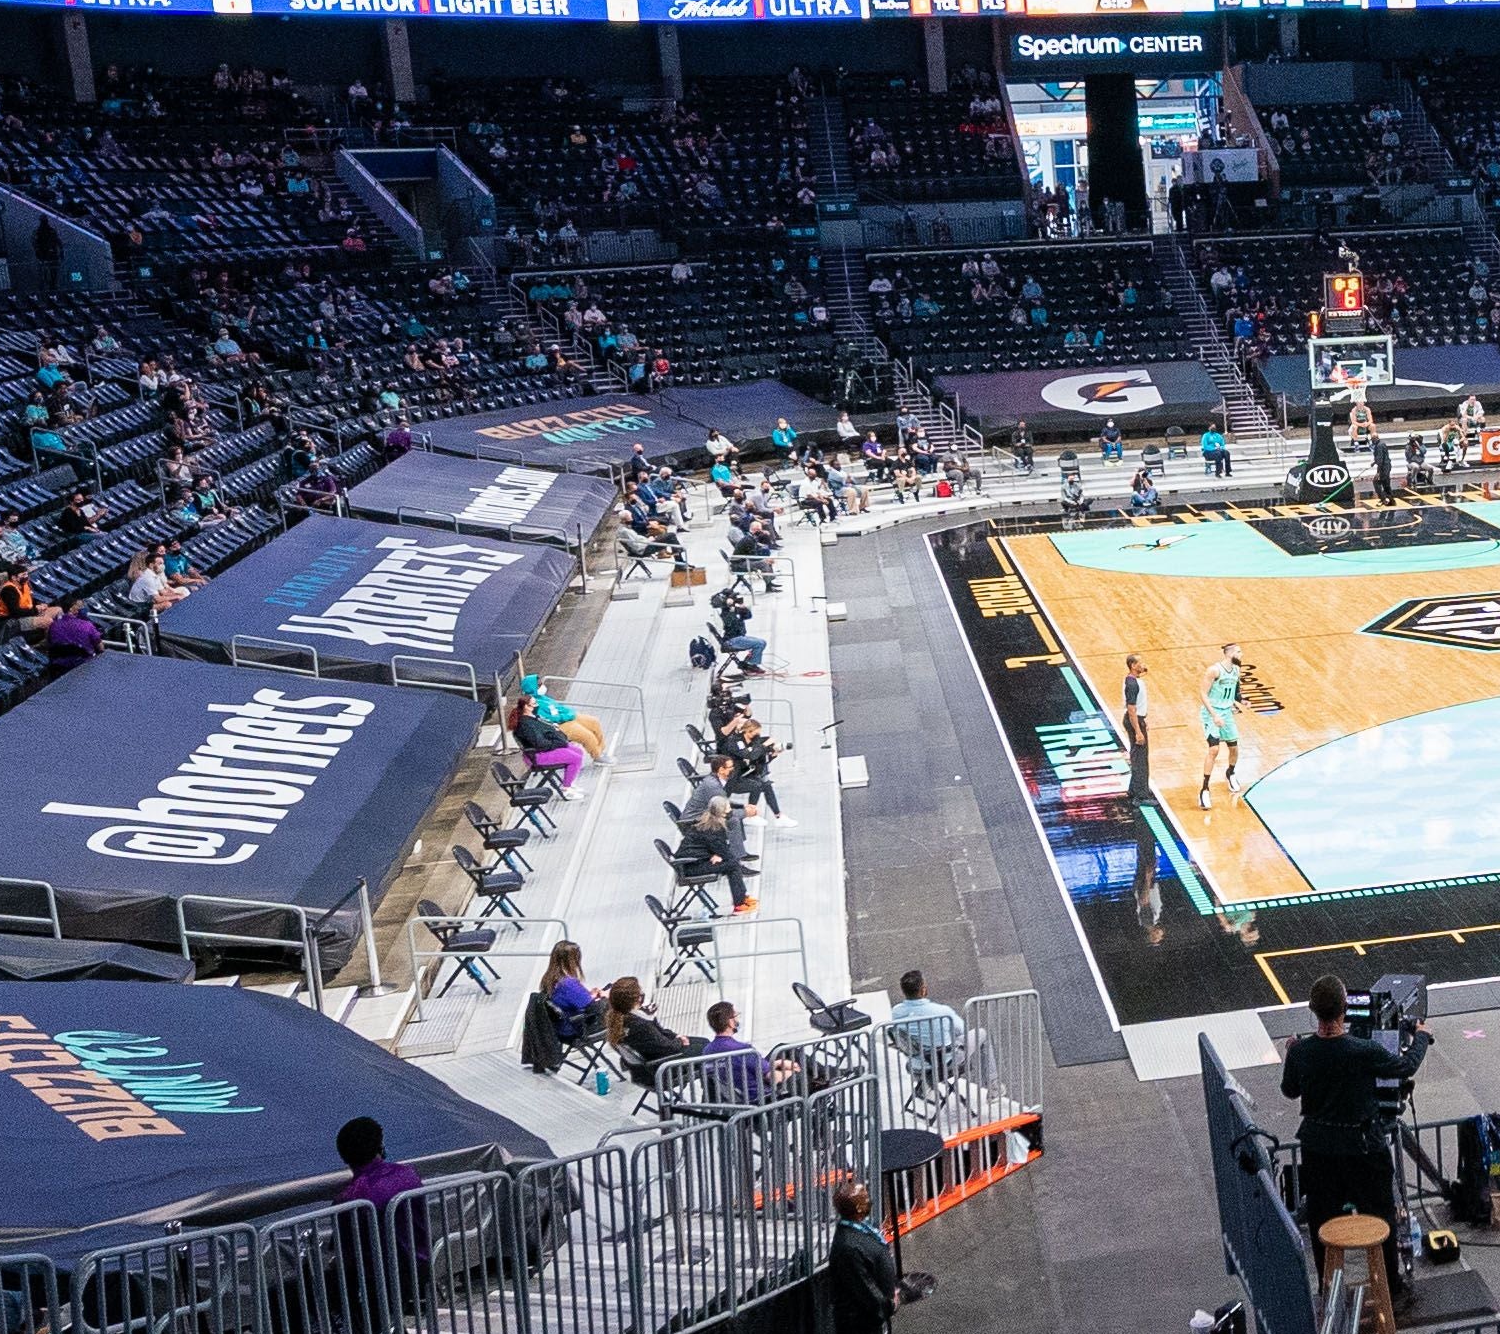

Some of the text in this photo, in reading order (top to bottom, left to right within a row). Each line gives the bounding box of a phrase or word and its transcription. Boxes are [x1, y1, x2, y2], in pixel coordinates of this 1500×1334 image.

[1018, 34, 1202, 59] Spectrum CENTER
[474, 402, 651, 441] BUZZ CITY
[1313, 468, 1343, 484] KIA
[264, 542, 373, 609] CHARLOTTE
[277, 535, 526, 655] HORNETS
[968, 571, 1036, 618] TRADE
[1223, 687, 1232, 700] 11
[41, 687, 377, 866] @hornets
[10, 1064, 186, 1143] BUZZ
